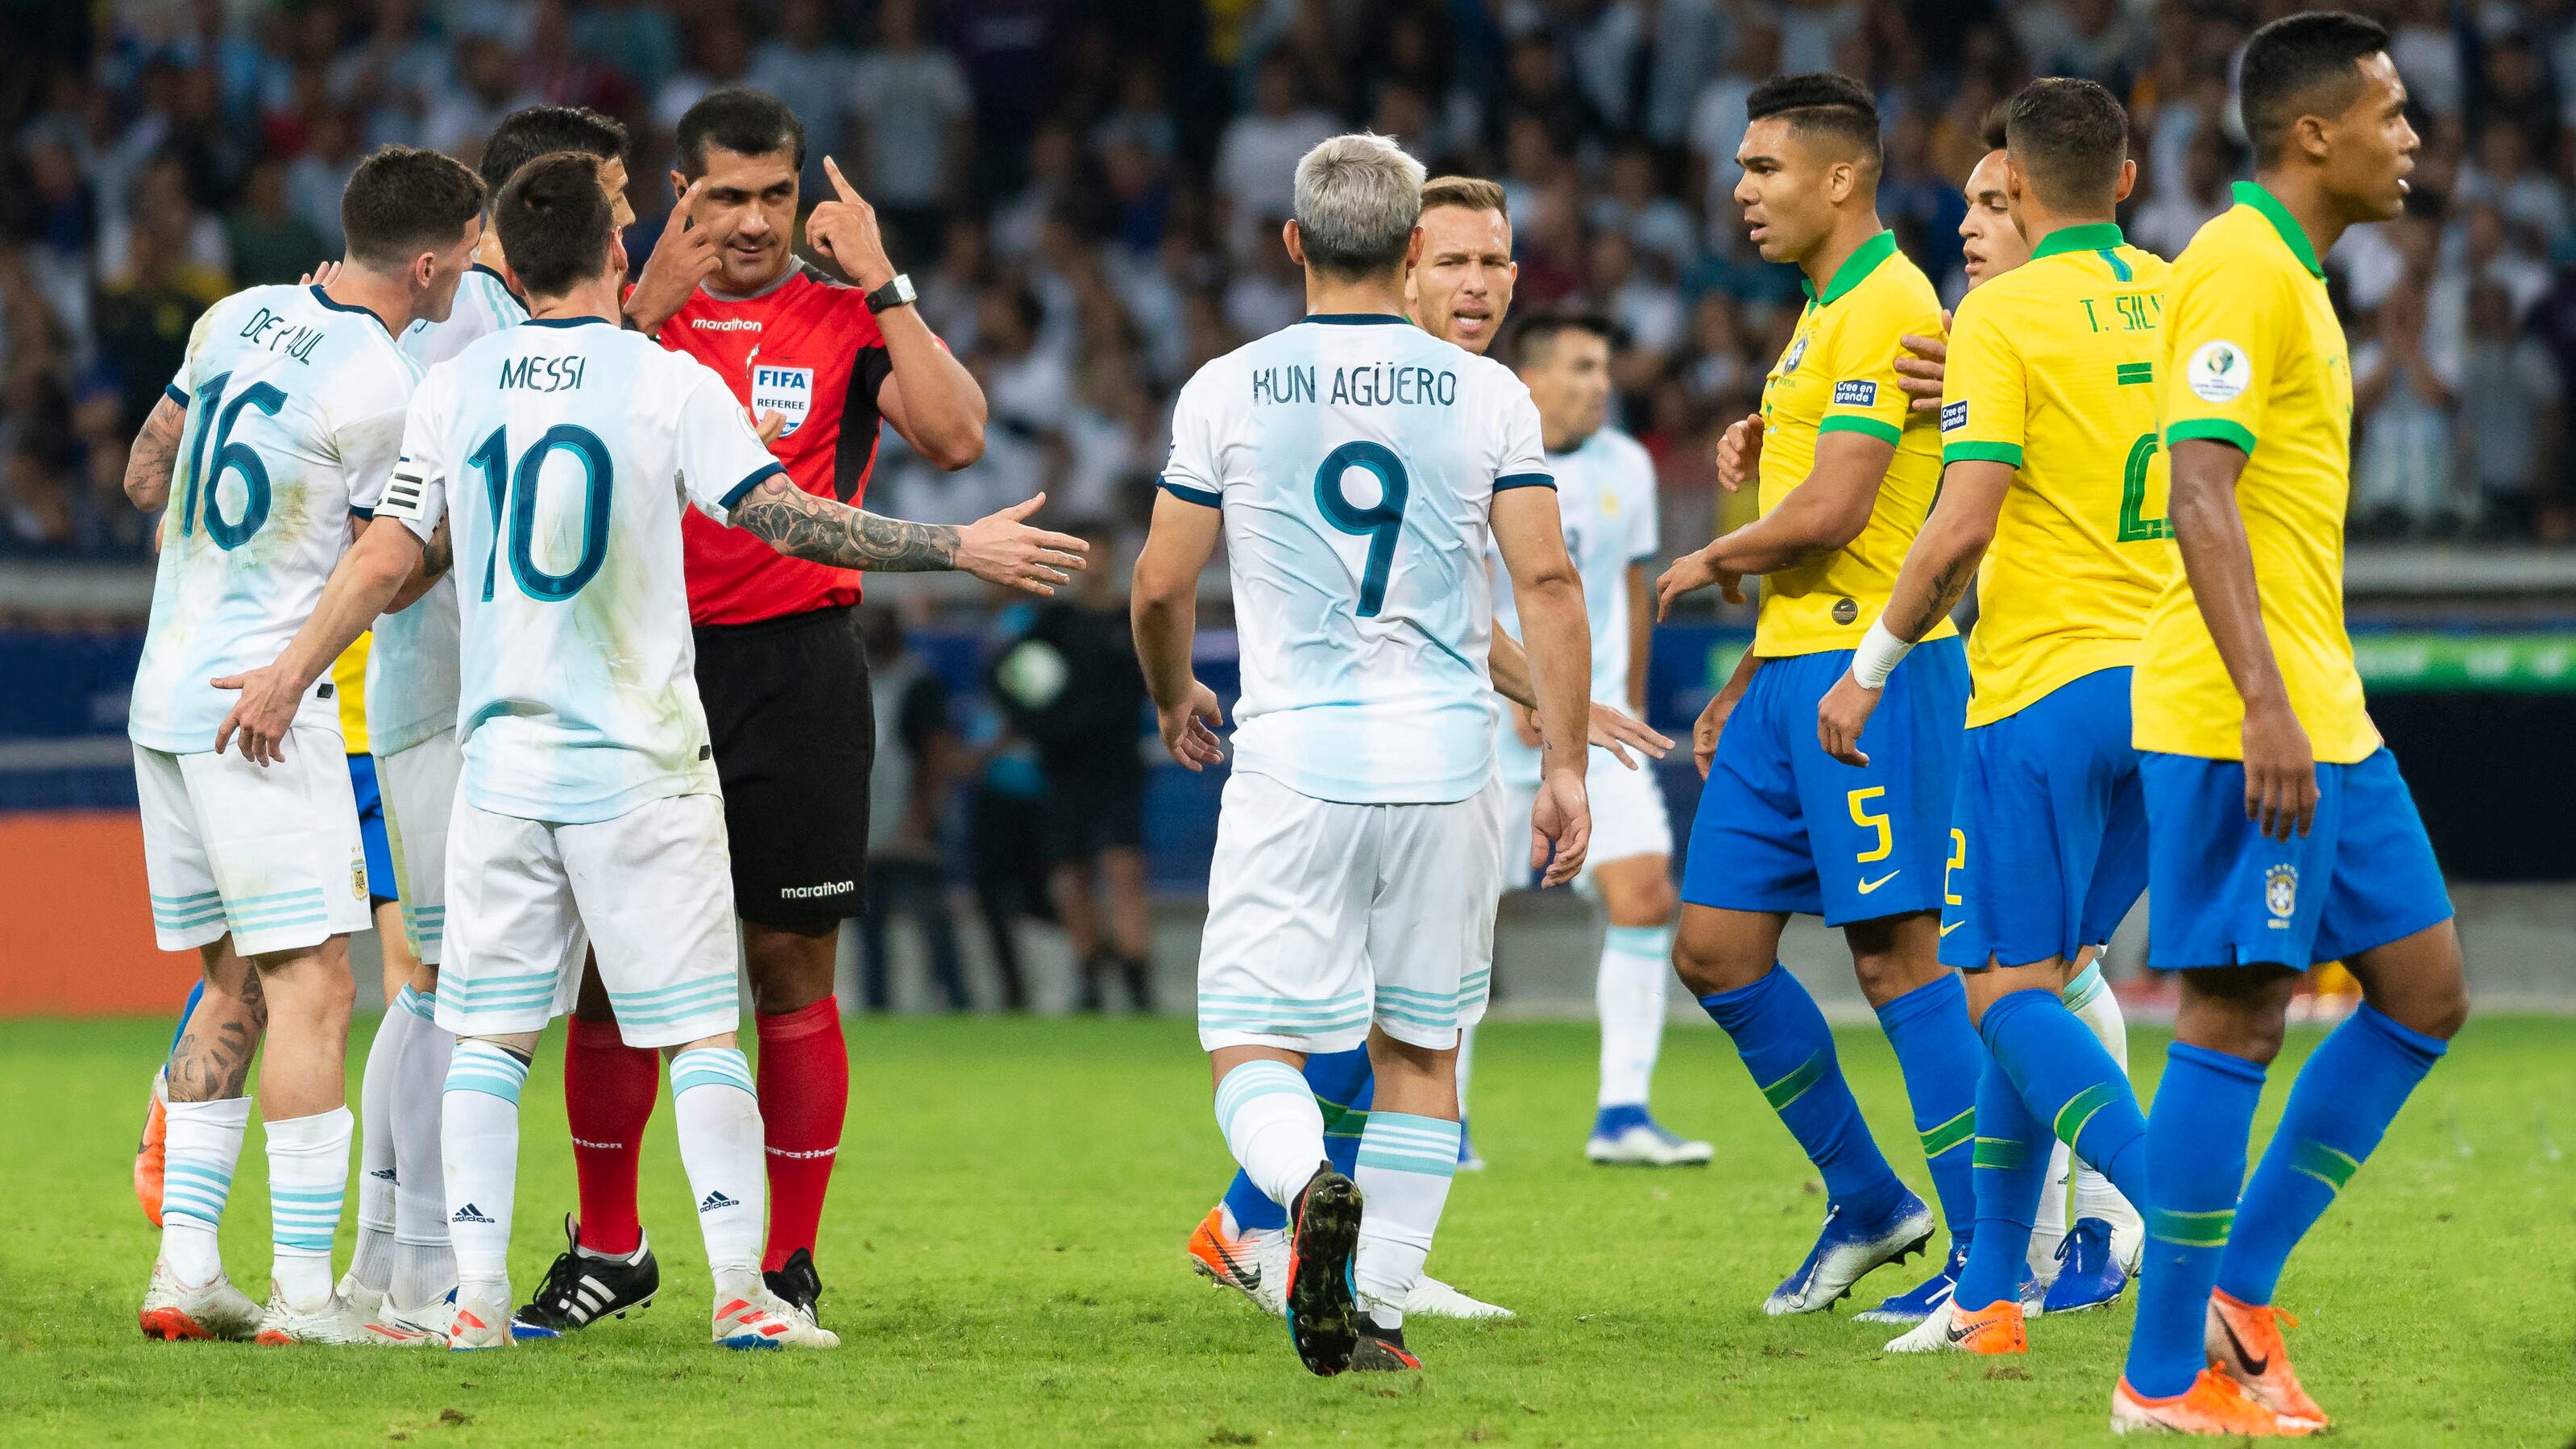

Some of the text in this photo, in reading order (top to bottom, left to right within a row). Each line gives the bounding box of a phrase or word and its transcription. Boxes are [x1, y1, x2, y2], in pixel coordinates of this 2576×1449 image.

[691, 318, 762, 332] marathon
[2080, 299, 2109, 332] T.
[239, 307, 285, 344] DE
[500, 355, 586, 393] MESSI
[758, 370, 806, 389] FIFA
[1252, 362, 1457, 407] KUN AGÜERO
[1837, 382, 1873, 394] Cree en
[757, 398, 805, 410] REFEREE
[1835, 392, 1869, 403] grande
[1942, 405, 1966, 419] Cree en
[1942, 413, 1964, 431] grande
[181, 370, 288, 552] 16
[467, 423, 613, 603] 10
[1313, 441, 1409, 617] 9
[1847, 786, 1893, 863] 5
[1944, 828, 1966, 906] 2
[781, 880, 854, 899] marathon
[765, 1145, 839, 1159] arathon
[699, 1200, 740, 1213] adidas
[452, 1215, 496, 1223] adidas
